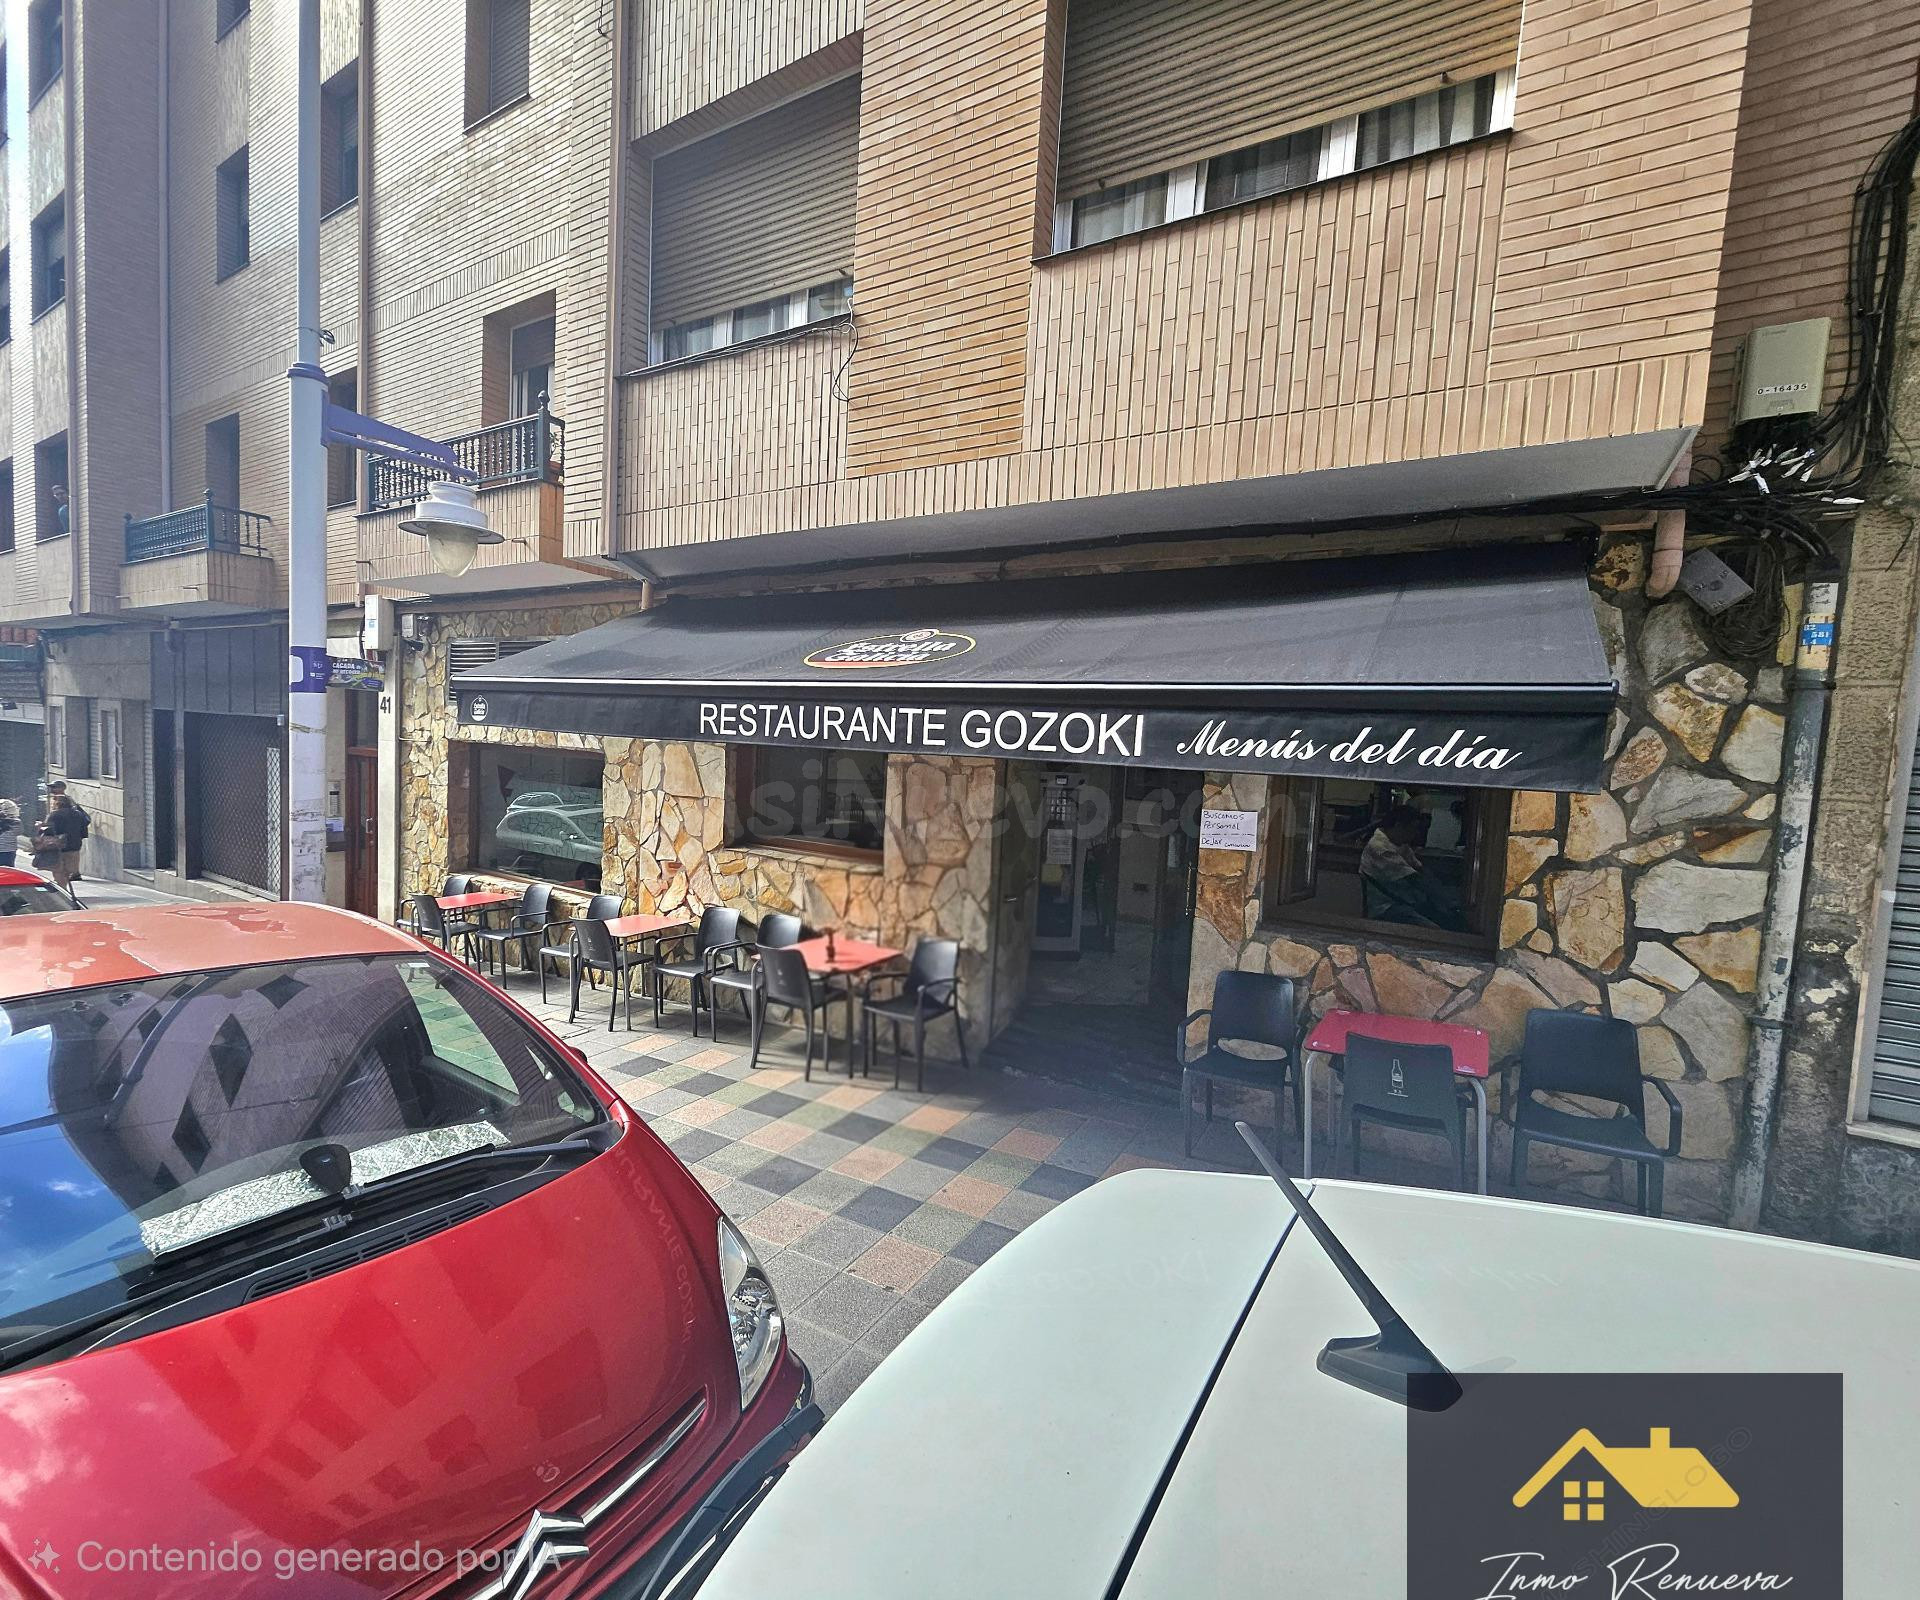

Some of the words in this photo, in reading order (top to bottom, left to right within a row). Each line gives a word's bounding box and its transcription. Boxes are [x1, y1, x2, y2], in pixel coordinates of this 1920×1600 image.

[380, 697, 391, 714] 41
[700, 703, 946, 746] RESTAURANTE
[960, 709, 1144, 757] GOZOKI
[1176, 719, 1329, 759] Menús
[1329, 727, 1417, 765] del
[1418, 730, 1523, 770] día
